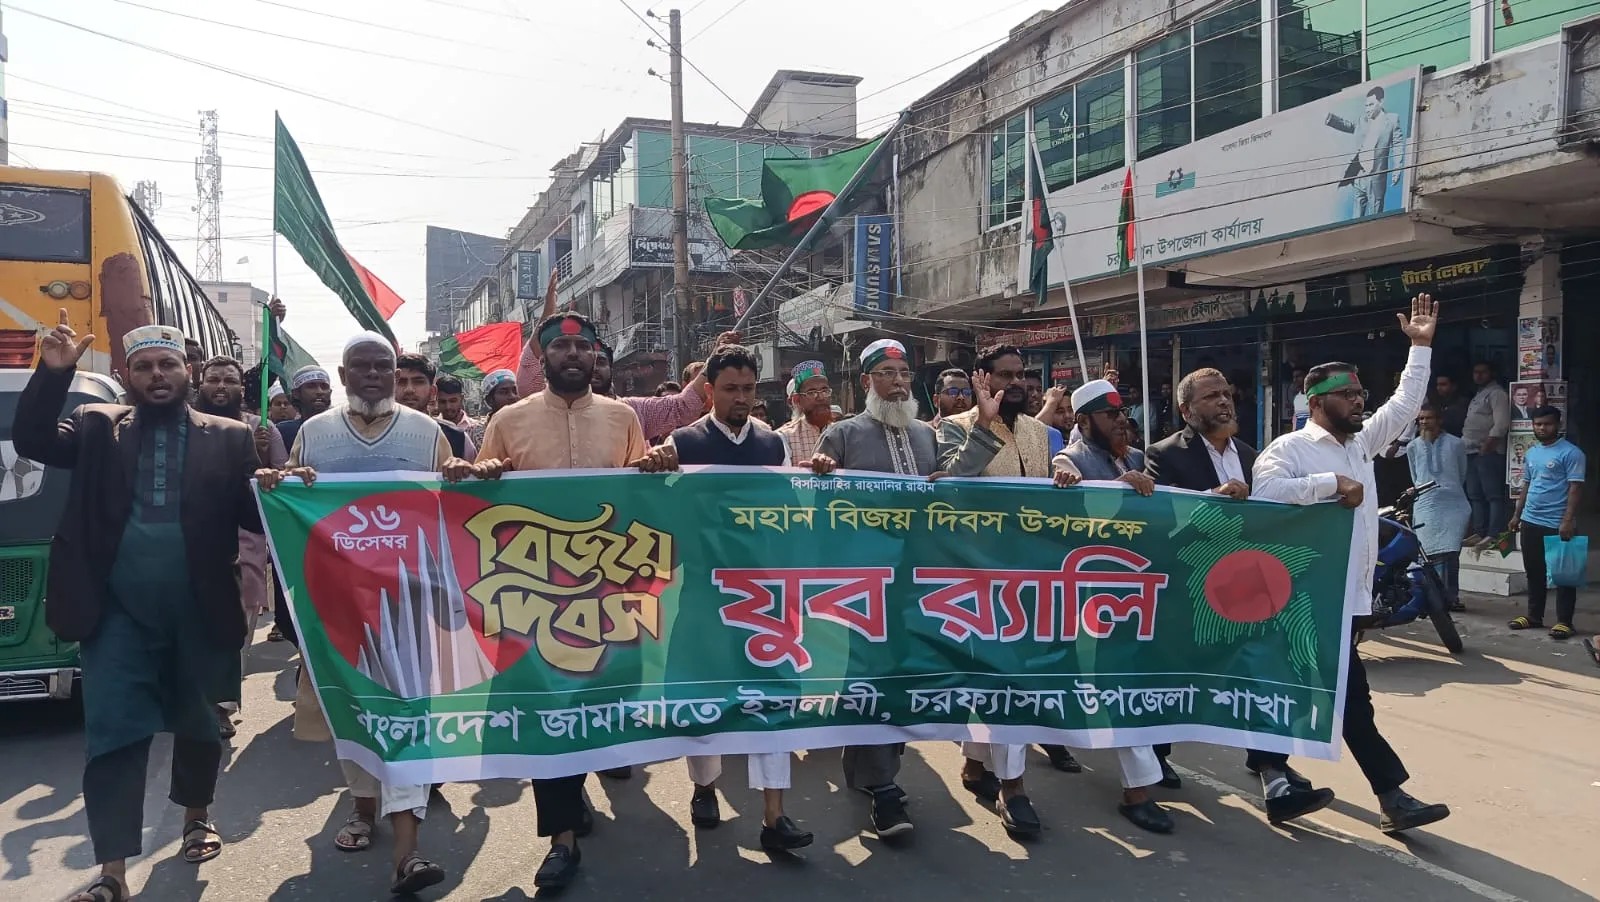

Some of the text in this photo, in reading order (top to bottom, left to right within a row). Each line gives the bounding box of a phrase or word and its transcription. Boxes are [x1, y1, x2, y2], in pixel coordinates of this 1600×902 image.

[1156, 229, 1209, 255] উপজেলা
[1211, 217, 1264, 243] কার্যালয়
[866, 223, 882, 311] SAMSUNG
[790, 475, 851, 491] বিসমিল্লাহির
[331, 531, 409, 552] ডিসেম্বর
[348, 505, 400, 534] ১৬
[463, 502, 673, 586] বিজয়
[728, 500, 1148, 541] মহান বিজয় দিবস উপলক্ষে
[464, 568, 659, 672] দিবস
[711, 567, 895, 673] যুব
[535, 697, 729, 741] জামায়াতে
[736, 681, 892, 724] ইসলামী,
[905, 685, 1067, 720] চরফ্যাসন
[1072, 679, 1200, 718] উপজেলা
[1207, 686, 1298, 728] শাখা
